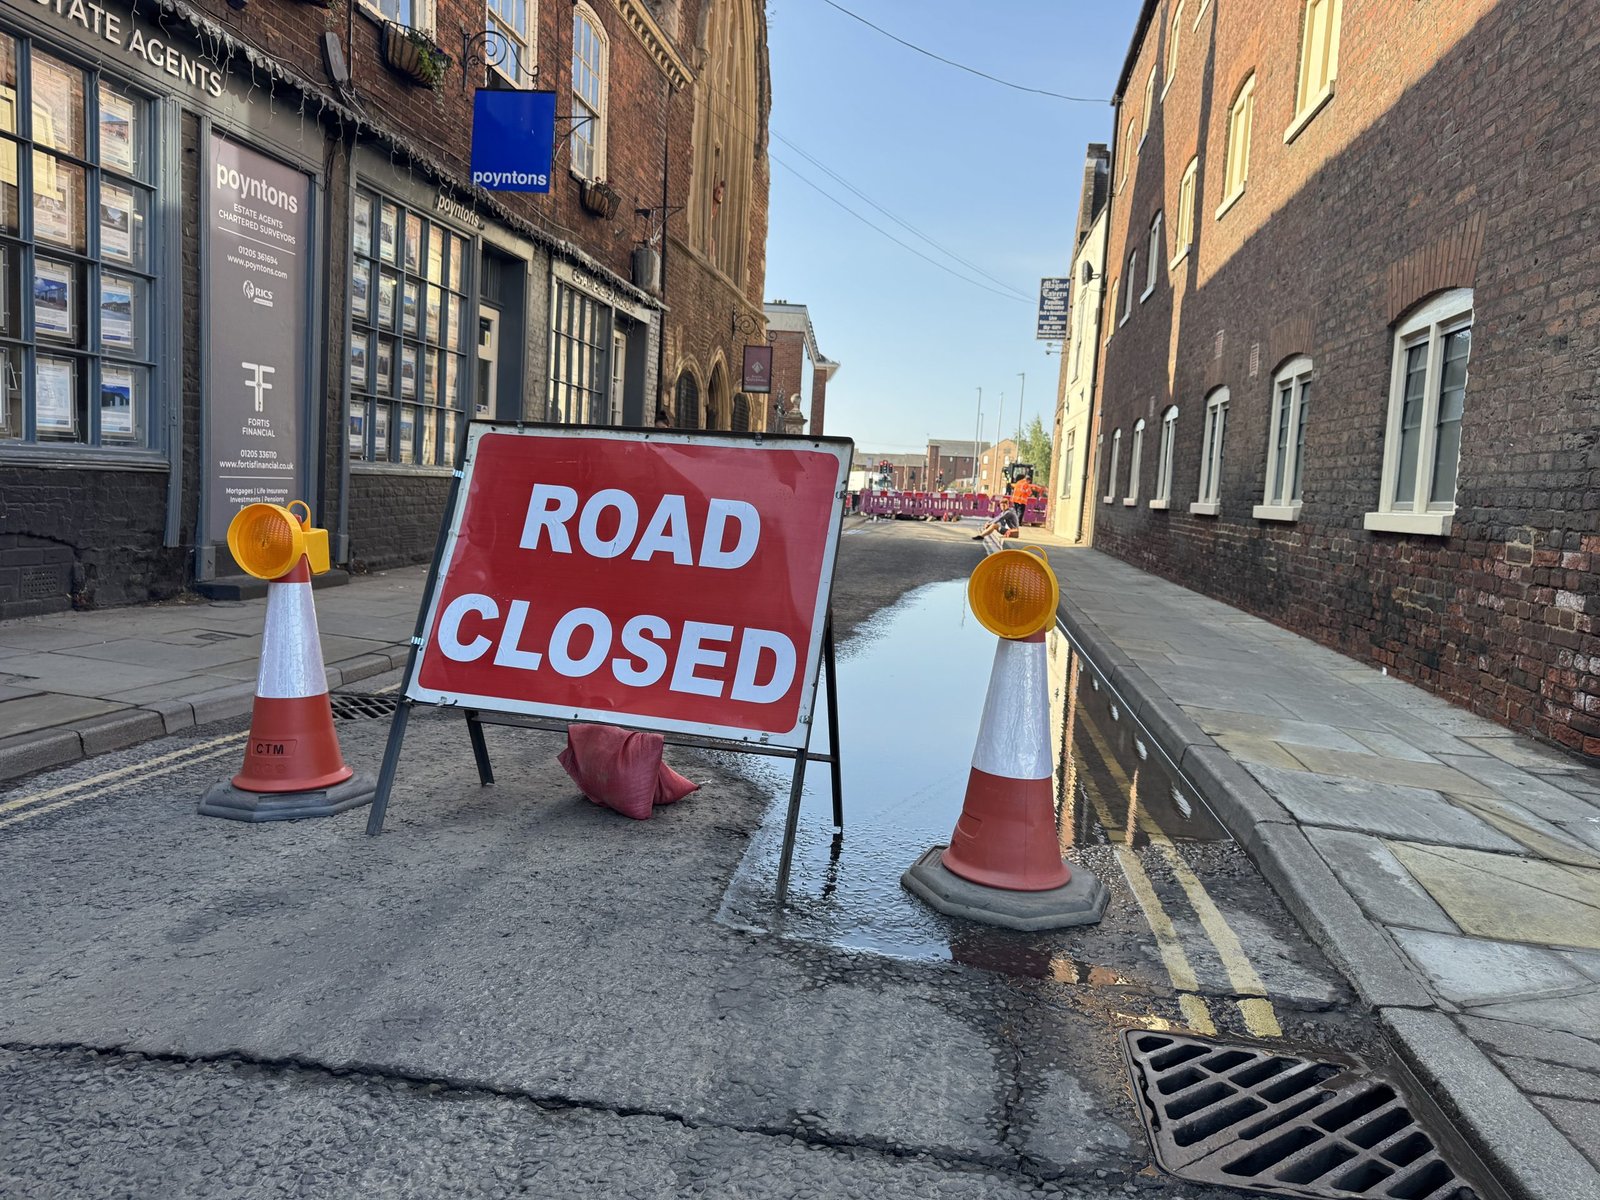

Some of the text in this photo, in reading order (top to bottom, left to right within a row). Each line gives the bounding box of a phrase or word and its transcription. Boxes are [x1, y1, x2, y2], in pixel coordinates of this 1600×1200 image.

[128, 28, 223, 98] AGENTS
[473, 170, 547, 187] poyntons
[216, 163, 298, 214] poyntons
[233, 203, 283, 229] ESTATE AGENTS
[437, 195, 480, 227] poyntons
[218, 209, 296, 245] CHARTERED SURVEYORS
[238, 245, 278, 265] 01205 361694
[227, 254, 288, 279] www.poyntons.com
[255, 287, 273, 300] RICS
[1042, 281, 1069, 291] Magnet
[1042, 289, 1068, 300] Tavern
[248, 418, 270, 427] FORTIS
[242, 427, 276, 437] FINANCIAL
[240, 449, 258, 458] 01205
[219, 460, 294, 470] www.fortisfinancial.co.uk
[226, 487, 253, 496] Mortgages
[519, 483, 761, 569] ROAD
[437, 593, 797, 704] CLOSED
[256, 743, 284, 754] CTM
